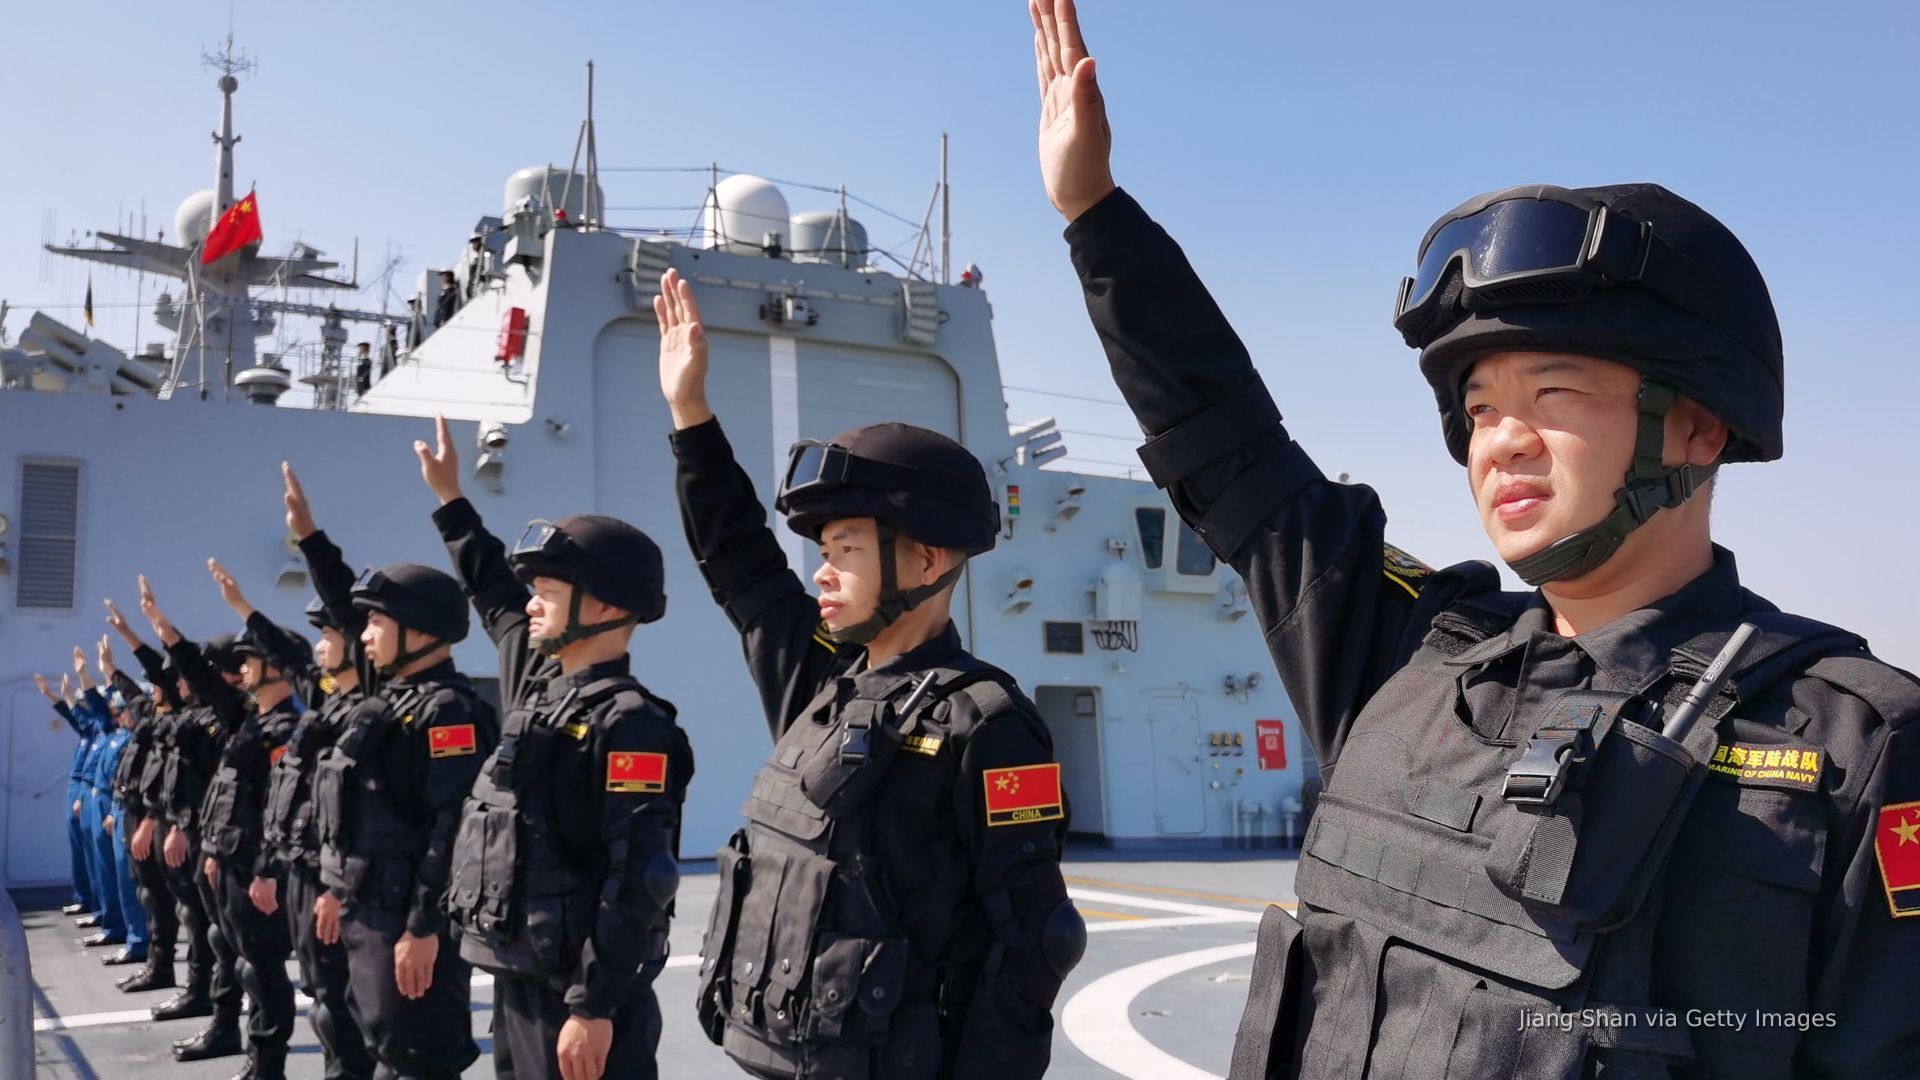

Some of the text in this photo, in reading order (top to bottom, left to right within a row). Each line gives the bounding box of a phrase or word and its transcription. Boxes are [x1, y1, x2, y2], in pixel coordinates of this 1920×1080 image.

[1744, 770, 1757, 778] OF
[1757, 769, 1785, 778] CHINA
[1786, 771, 1815, 783] NAVY
[1012, 808, 1042, 820] CHINA
